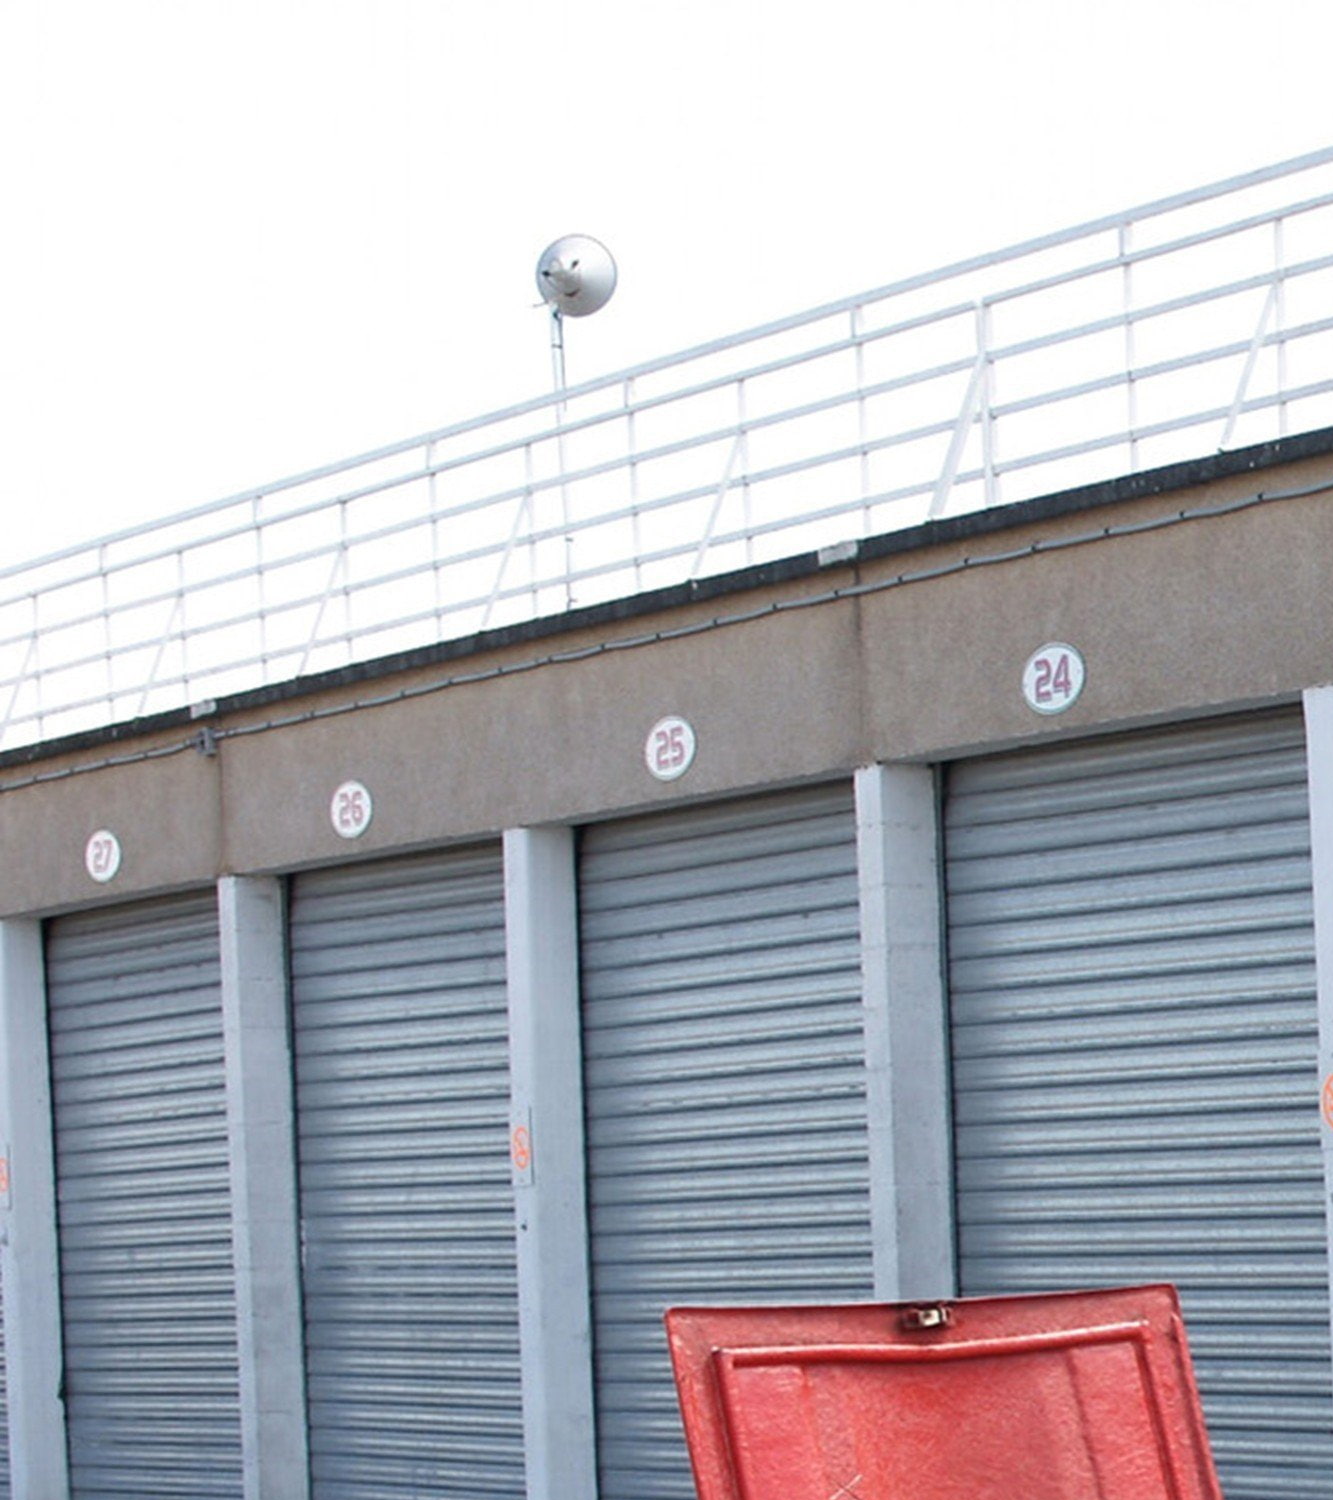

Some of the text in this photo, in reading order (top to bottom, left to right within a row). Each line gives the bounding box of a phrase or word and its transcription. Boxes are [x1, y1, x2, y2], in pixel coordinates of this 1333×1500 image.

[1034, 653, 1071, 703] 24
[656, 725, 685, 771] 25
[339, 790, 364, 828] 26
